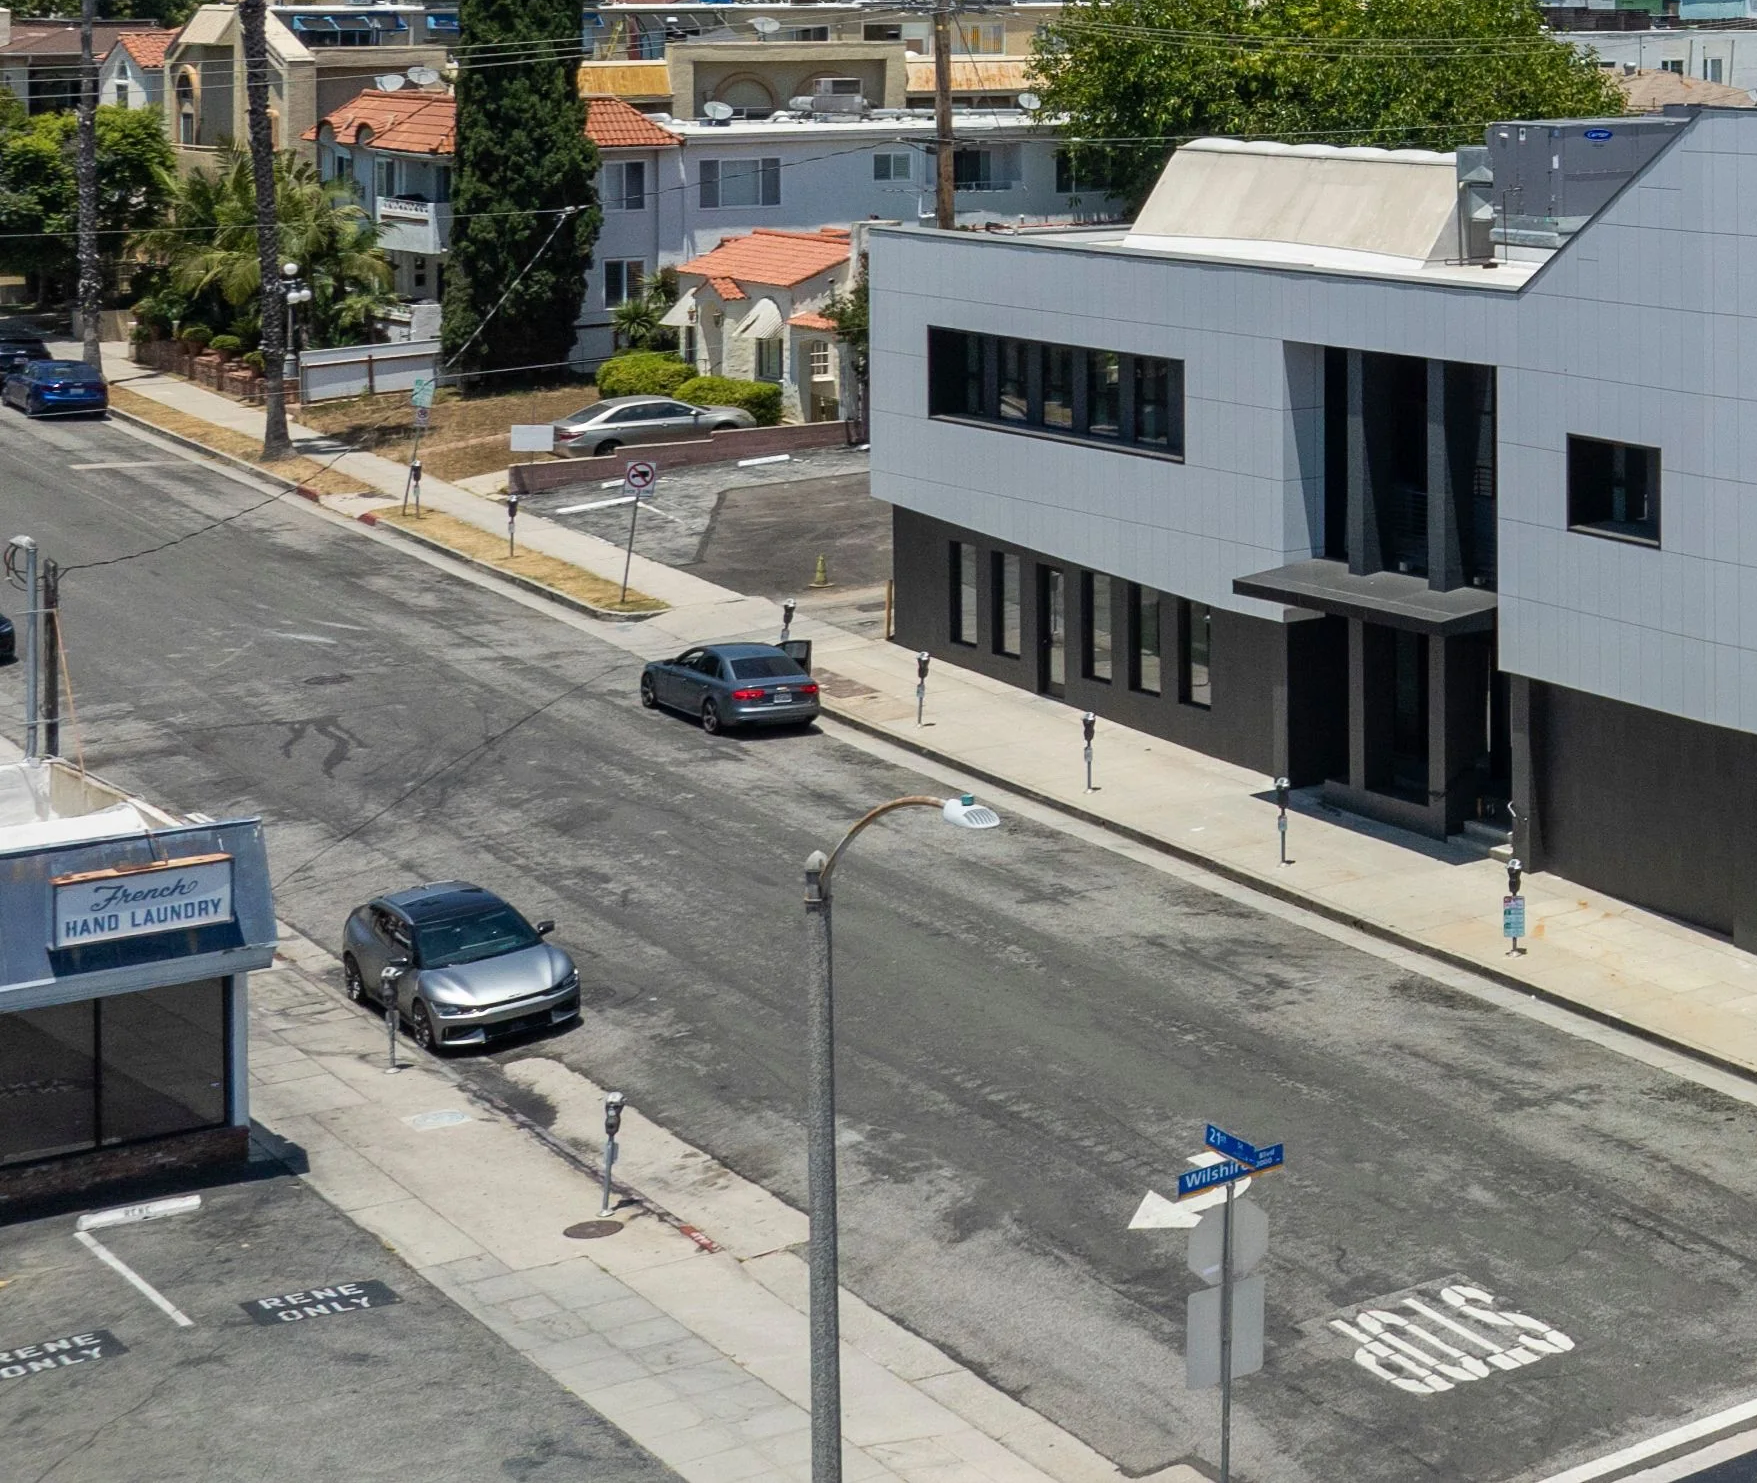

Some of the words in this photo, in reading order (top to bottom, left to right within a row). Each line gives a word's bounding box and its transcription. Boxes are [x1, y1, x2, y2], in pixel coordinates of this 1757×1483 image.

[90, 878, 198, 911] French
[65, 914, 119, 938] HAND
[131, 898, 222, 928] LAUNDRY
[257, 1283, 365, 1310] RENE
[277, 1296, 371, 1323] ONLY
[1329, 1284, 1575, 1393] STOP
[0, 1346, 103, 1379] ONLY
